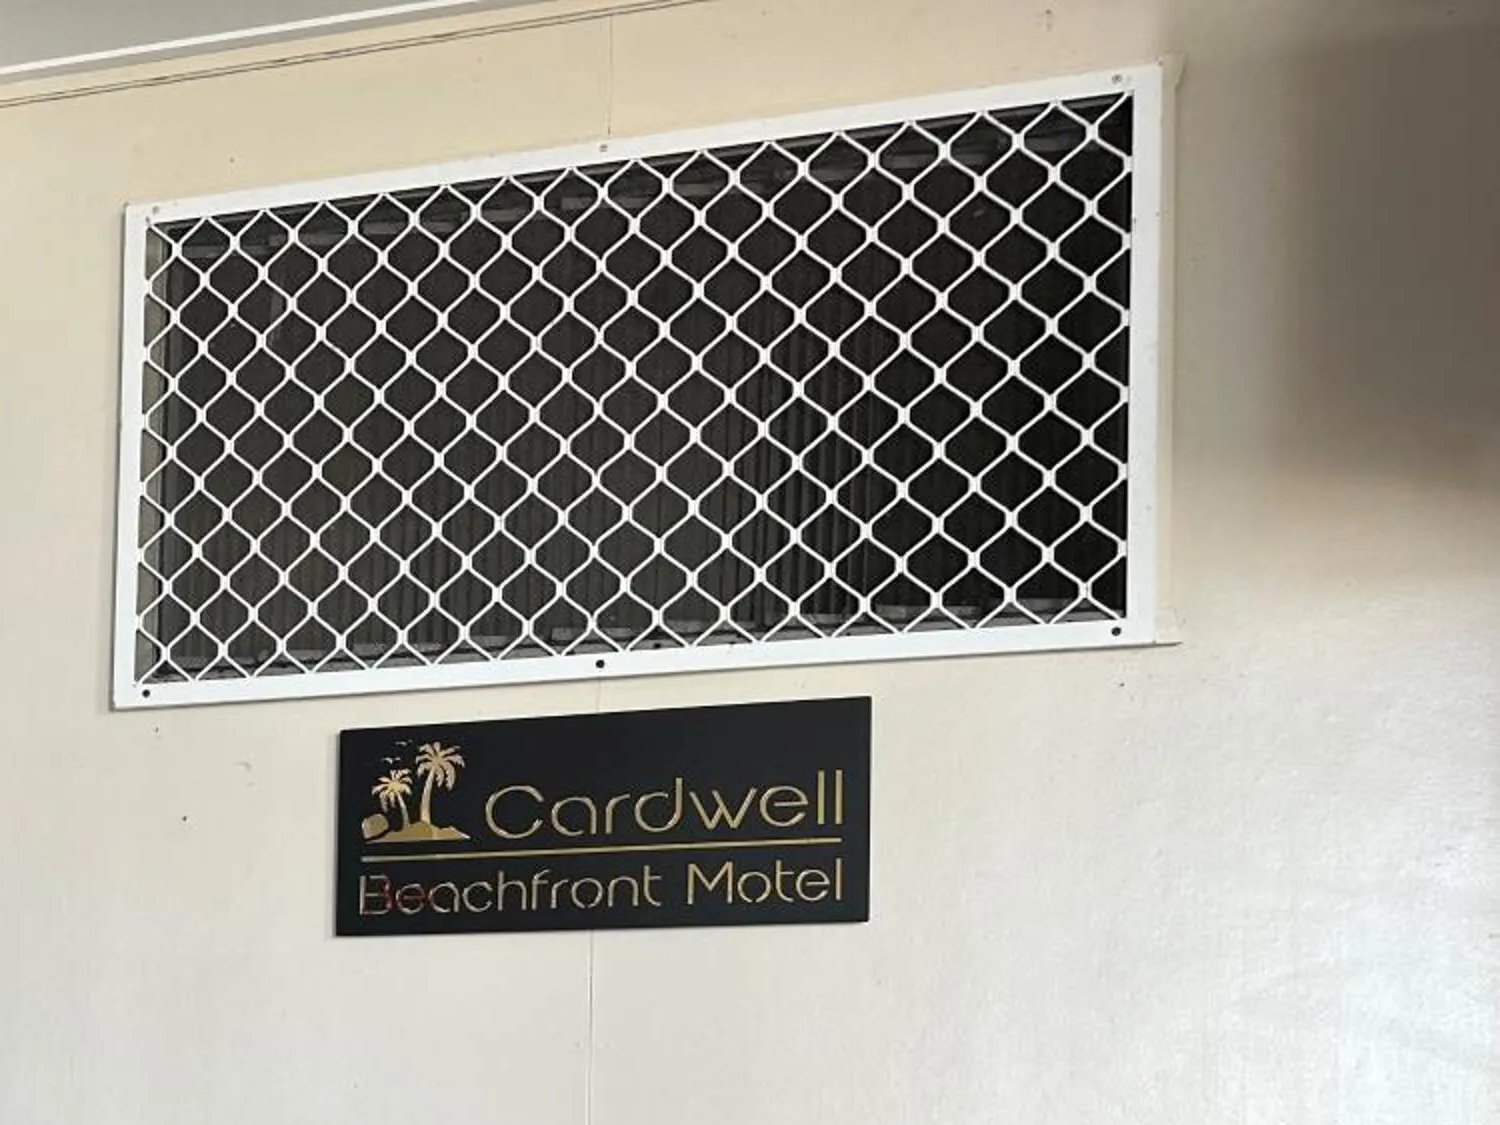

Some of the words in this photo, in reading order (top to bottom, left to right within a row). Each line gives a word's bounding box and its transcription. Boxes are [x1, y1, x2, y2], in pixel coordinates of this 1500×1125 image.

[484, 769, 844, 840] Cardwell
[358, 865, 663, 916] Beachfront
[686, 858, 844, 905] Motel
